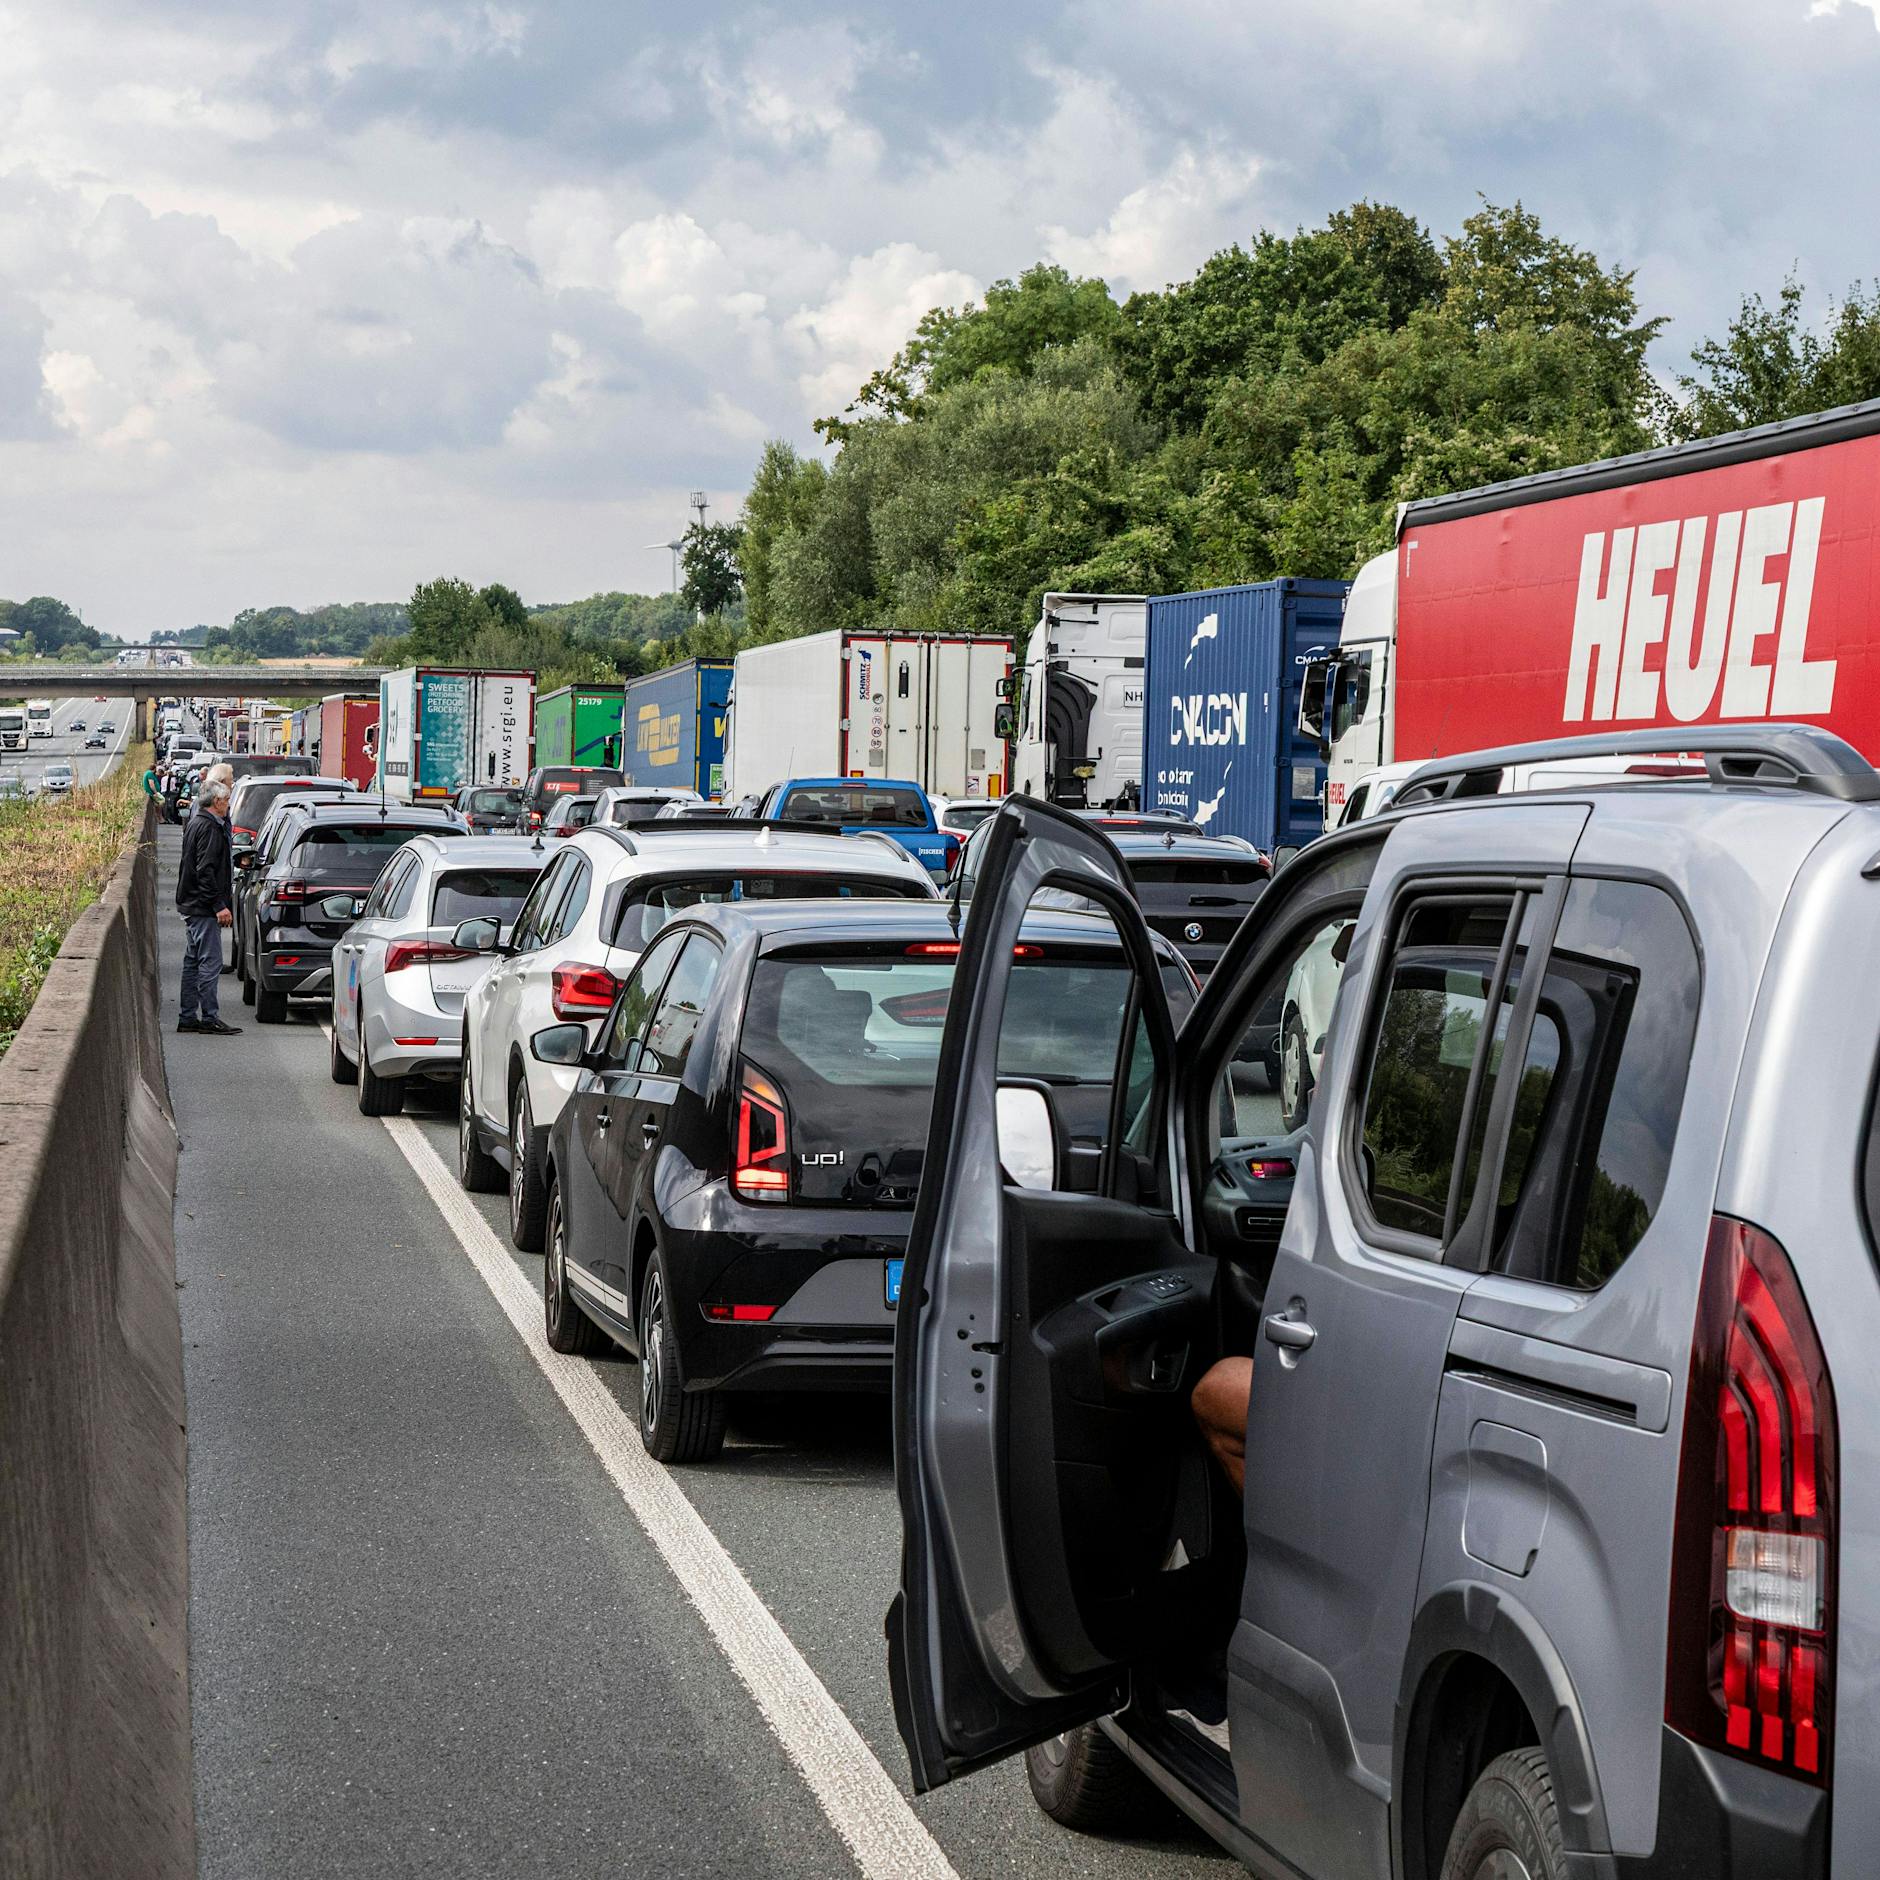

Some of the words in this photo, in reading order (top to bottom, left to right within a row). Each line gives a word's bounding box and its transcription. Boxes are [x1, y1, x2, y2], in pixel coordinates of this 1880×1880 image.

[1562, 496, 1838, 722] HEUEL
[428, 683, 464, 692] SWEETS
[427, 698, 464, 706] PETFOOD
[577, 697, 602, 706] 25179
[427, 705, 464, 713] GROCERY
[801, 1150, 844, 1169] up!
